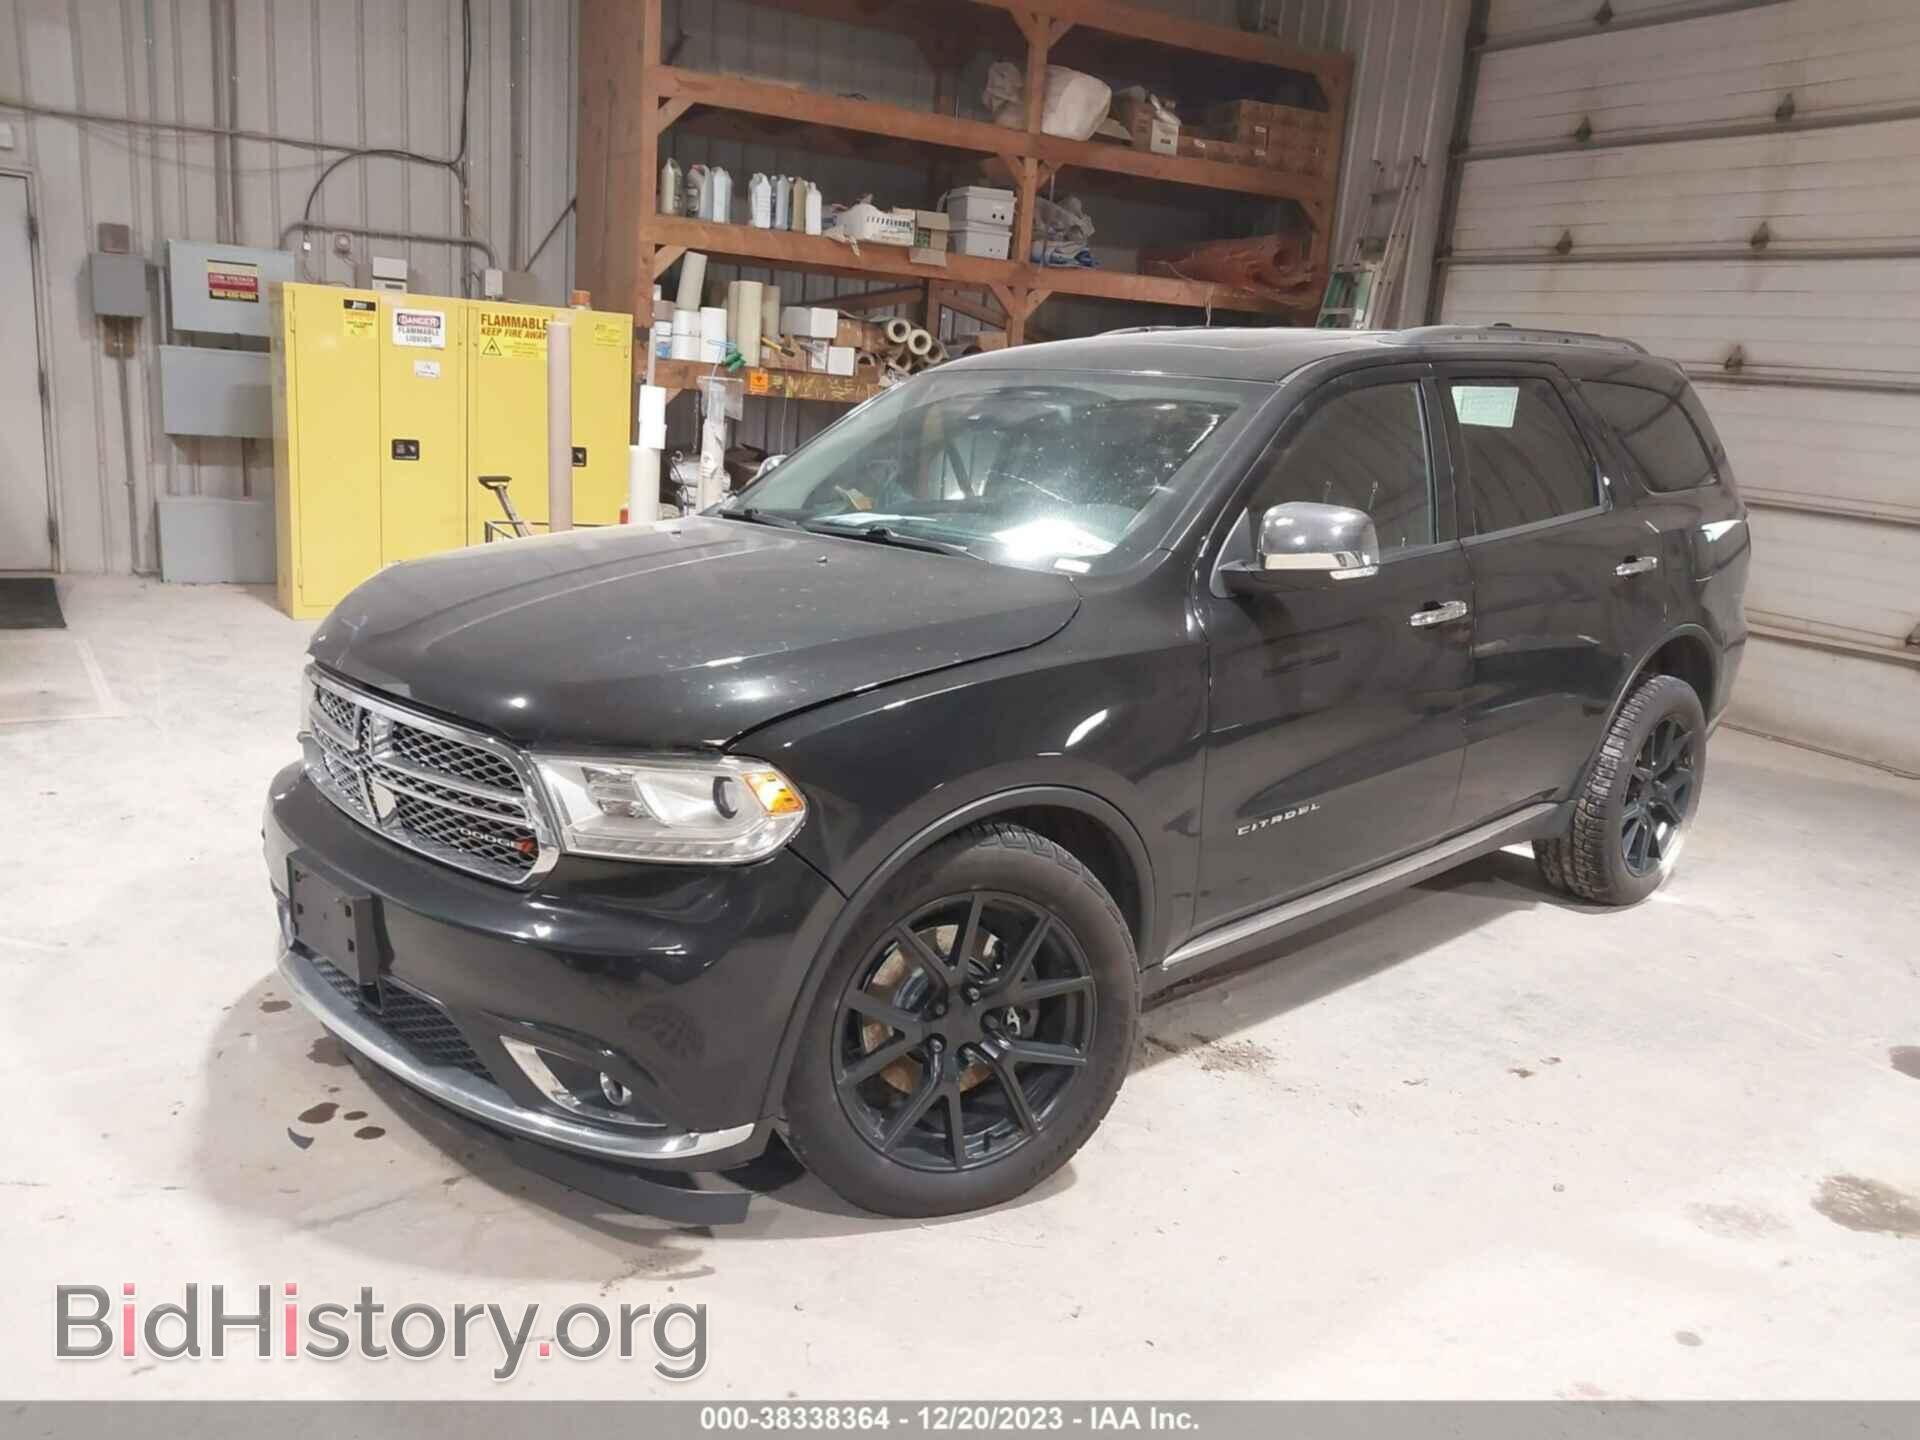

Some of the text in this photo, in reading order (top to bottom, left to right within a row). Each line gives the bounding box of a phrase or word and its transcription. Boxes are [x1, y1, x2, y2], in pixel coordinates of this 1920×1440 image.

[399, 314, 438, 327] DANGER
[481, 314, 548, 330] FLAMMABLE
[480, 327, 501, 336] KEEP
[504, 329, 521, 338] FIRE
[1237, 803, 1321, 836] CITADEL
[460, 827, 520, 850] DODGE
